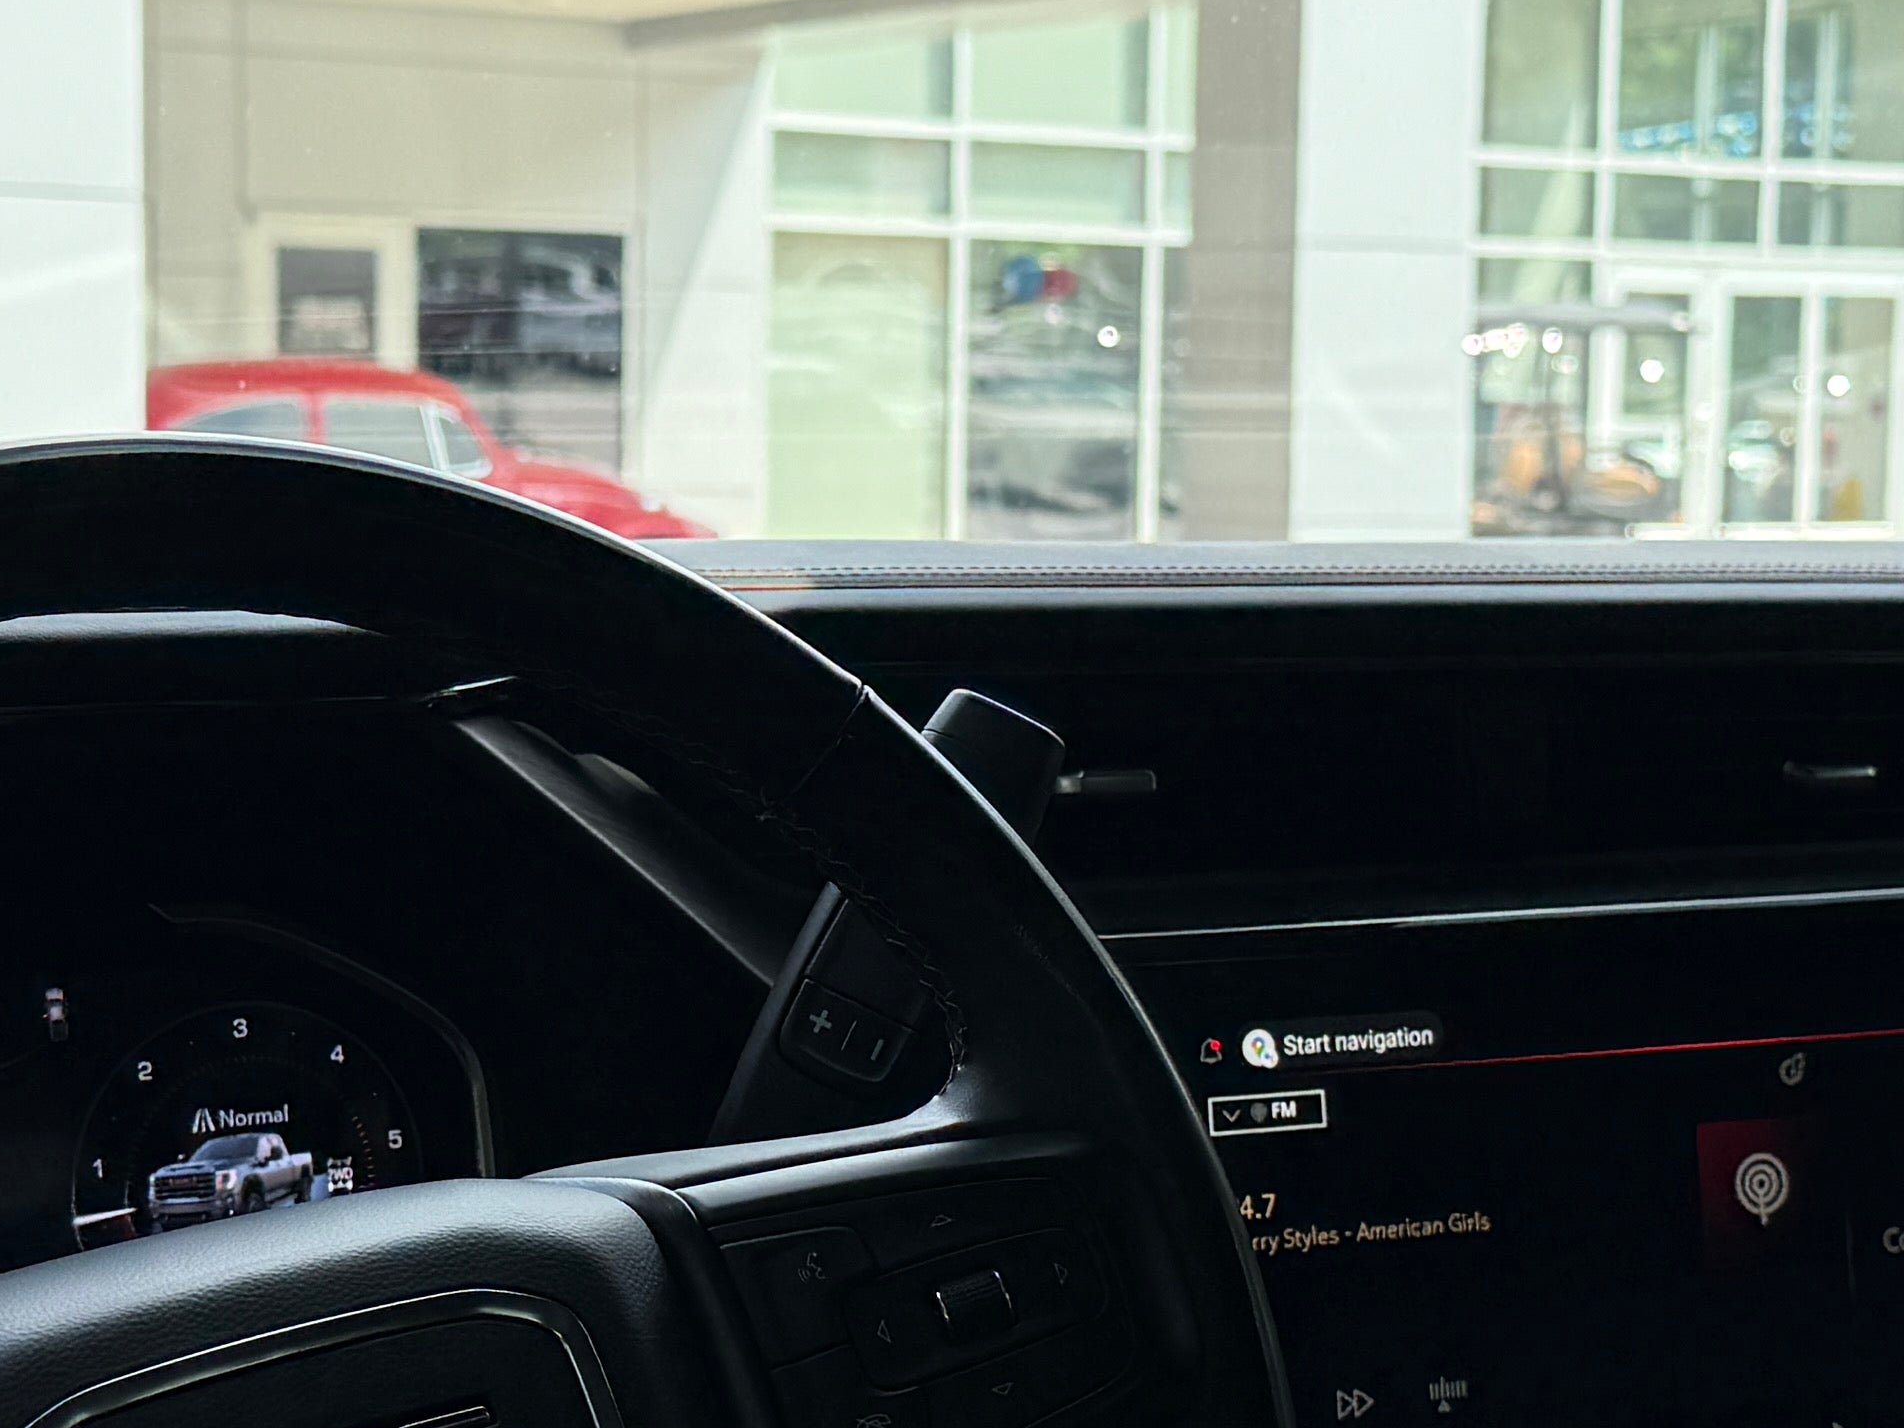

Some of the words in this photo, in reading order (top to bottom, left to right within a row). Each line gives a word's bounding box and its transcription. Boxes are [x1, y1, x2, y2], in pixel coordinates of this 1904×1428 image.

[232, 1018, 249, 1039] 3
[1282, 1032, 1331, 1057] Start
[1334, 1026, 1434, 1054] navigation
[329, 1044, 346, 1065] 4
[137, 1061, 153, 1082] 2
[219, 1103, 289, 1129] Normal
[1270, 1099, 1297, 1120] FM
[387, 1129, 403, 1150] 5
[92, 1158, 105, 1179] 1
[1283, 1224, 1341, 1255] Styles
[1356, 1217, 1445, 1244] American
[1448, 1210, 1492, 1234] Girls
